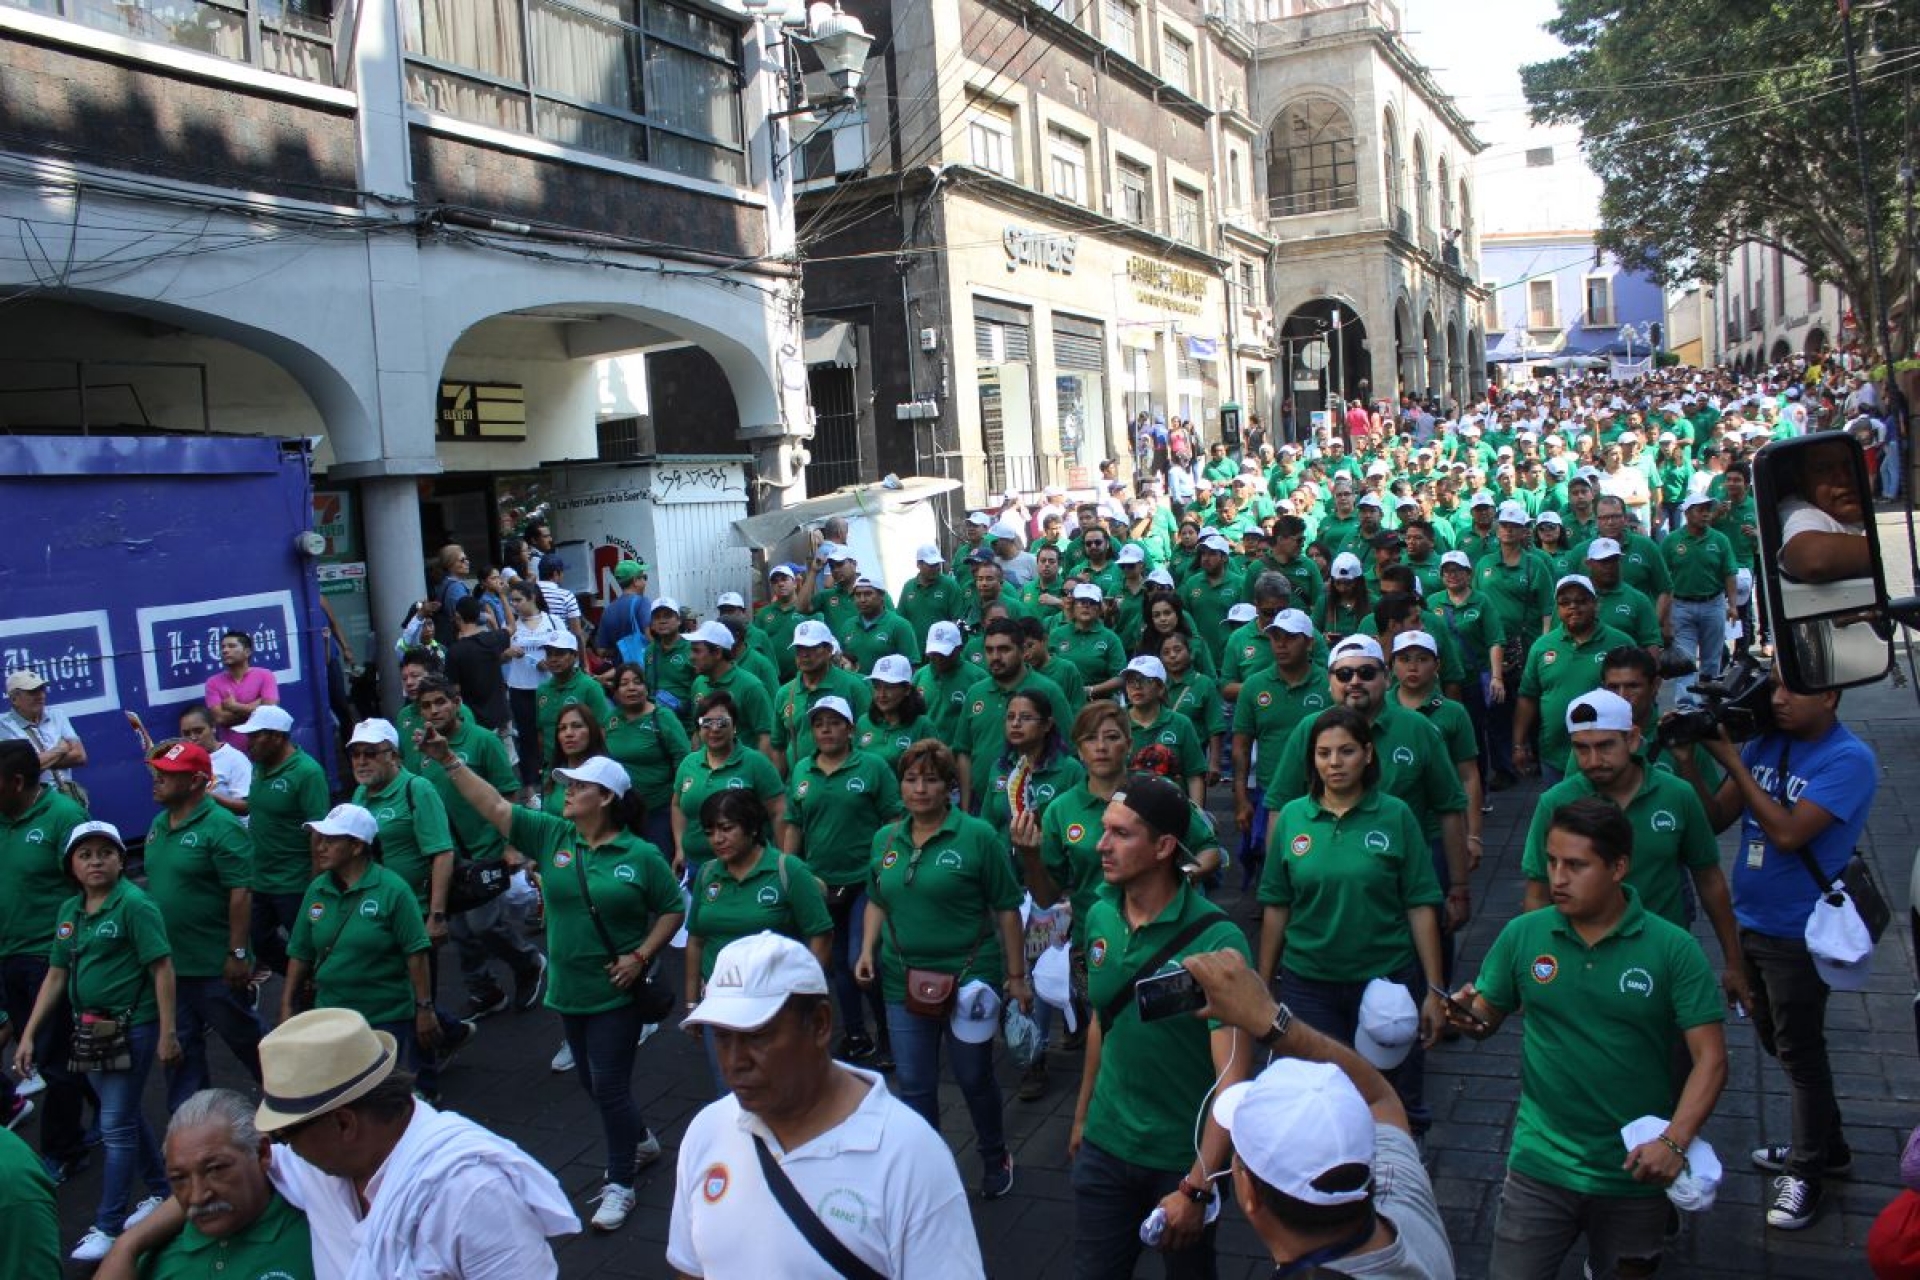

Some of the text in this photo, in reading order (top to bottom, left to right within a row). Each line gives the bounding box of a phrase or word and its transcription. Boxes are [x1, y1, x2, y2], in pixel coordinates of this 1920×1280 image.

[443, 385, 471, 435] 7
[606, 534, 644, 566] Naciona
[168, 631, 203, 668] La
